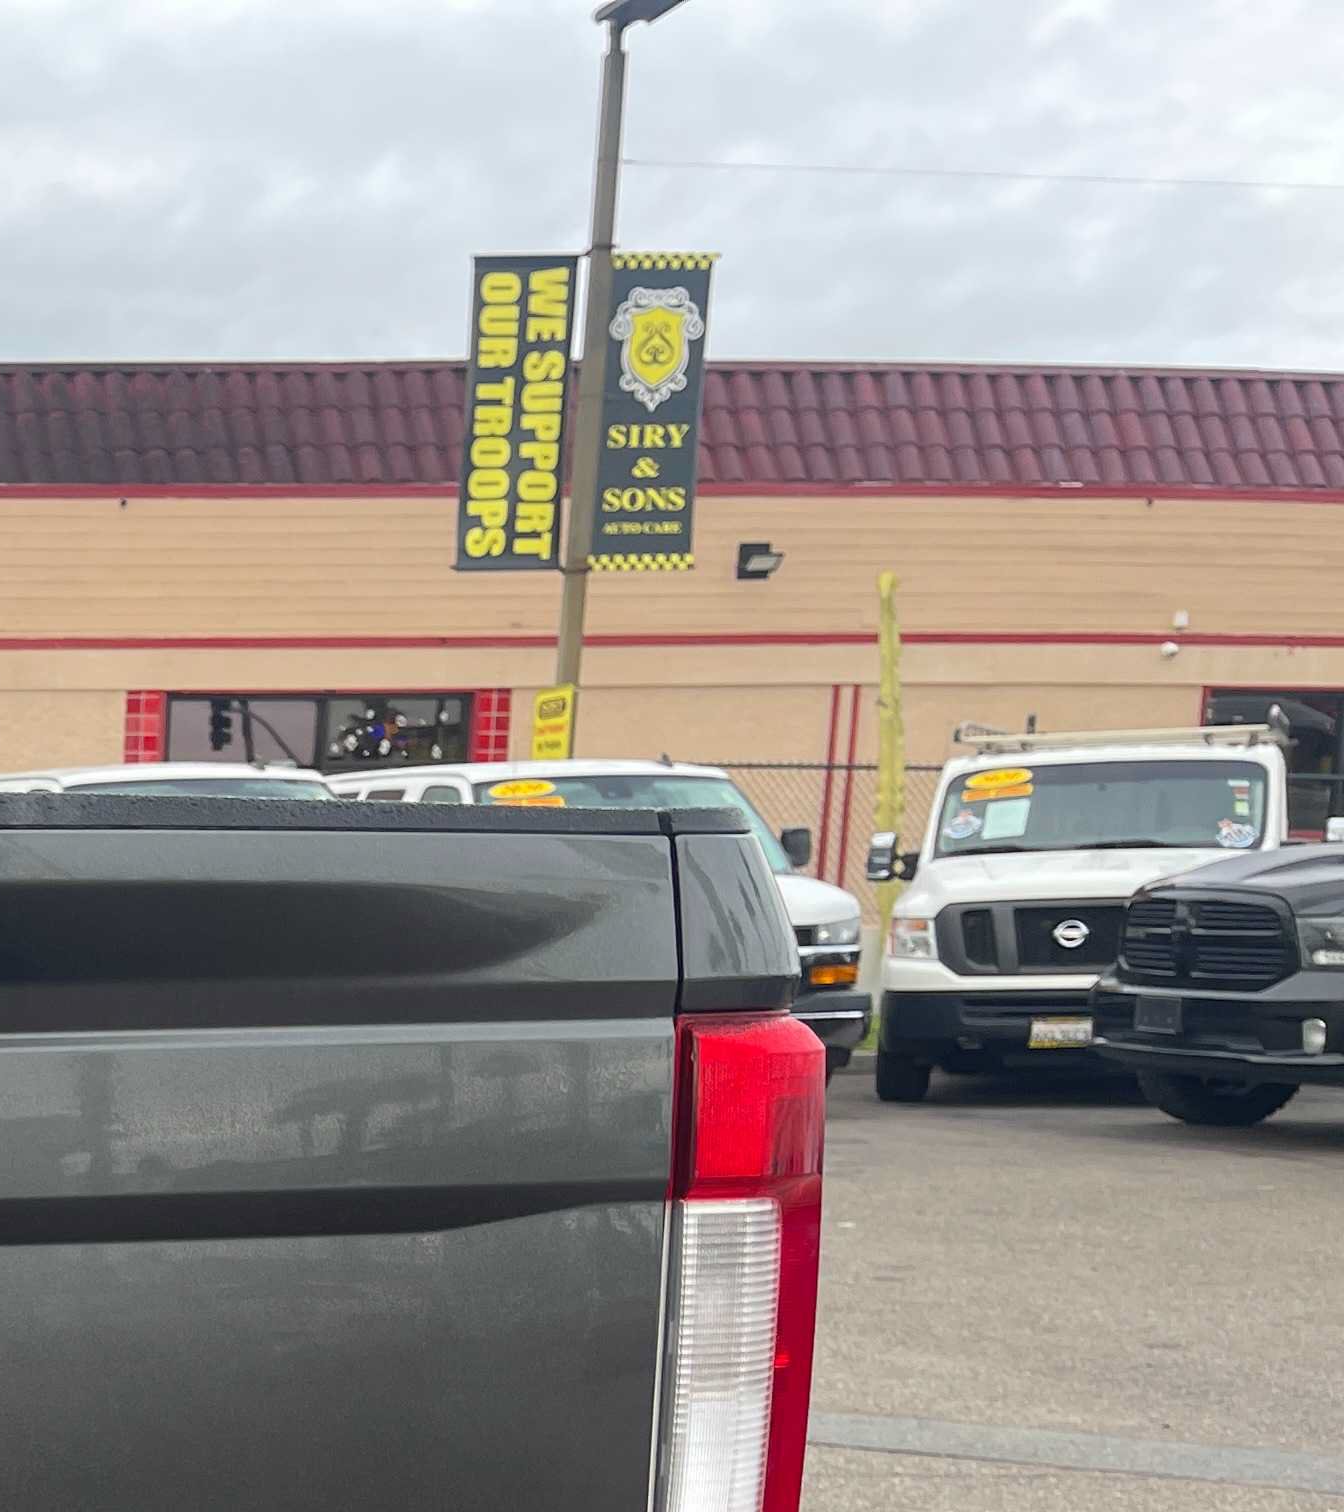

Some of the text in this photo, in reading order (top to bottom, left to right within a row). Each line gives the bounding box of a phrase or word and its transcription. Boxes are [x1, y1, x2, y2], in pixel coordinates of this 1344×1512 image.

[464, 272, 522, 558] OUR TROOPS
[512, 266, 570, 560] WE SUPPORT
[606, 423, 690, 449] SIRY
[632, 457, 660, 479] &
[602, 488, 687, 512] SONS
